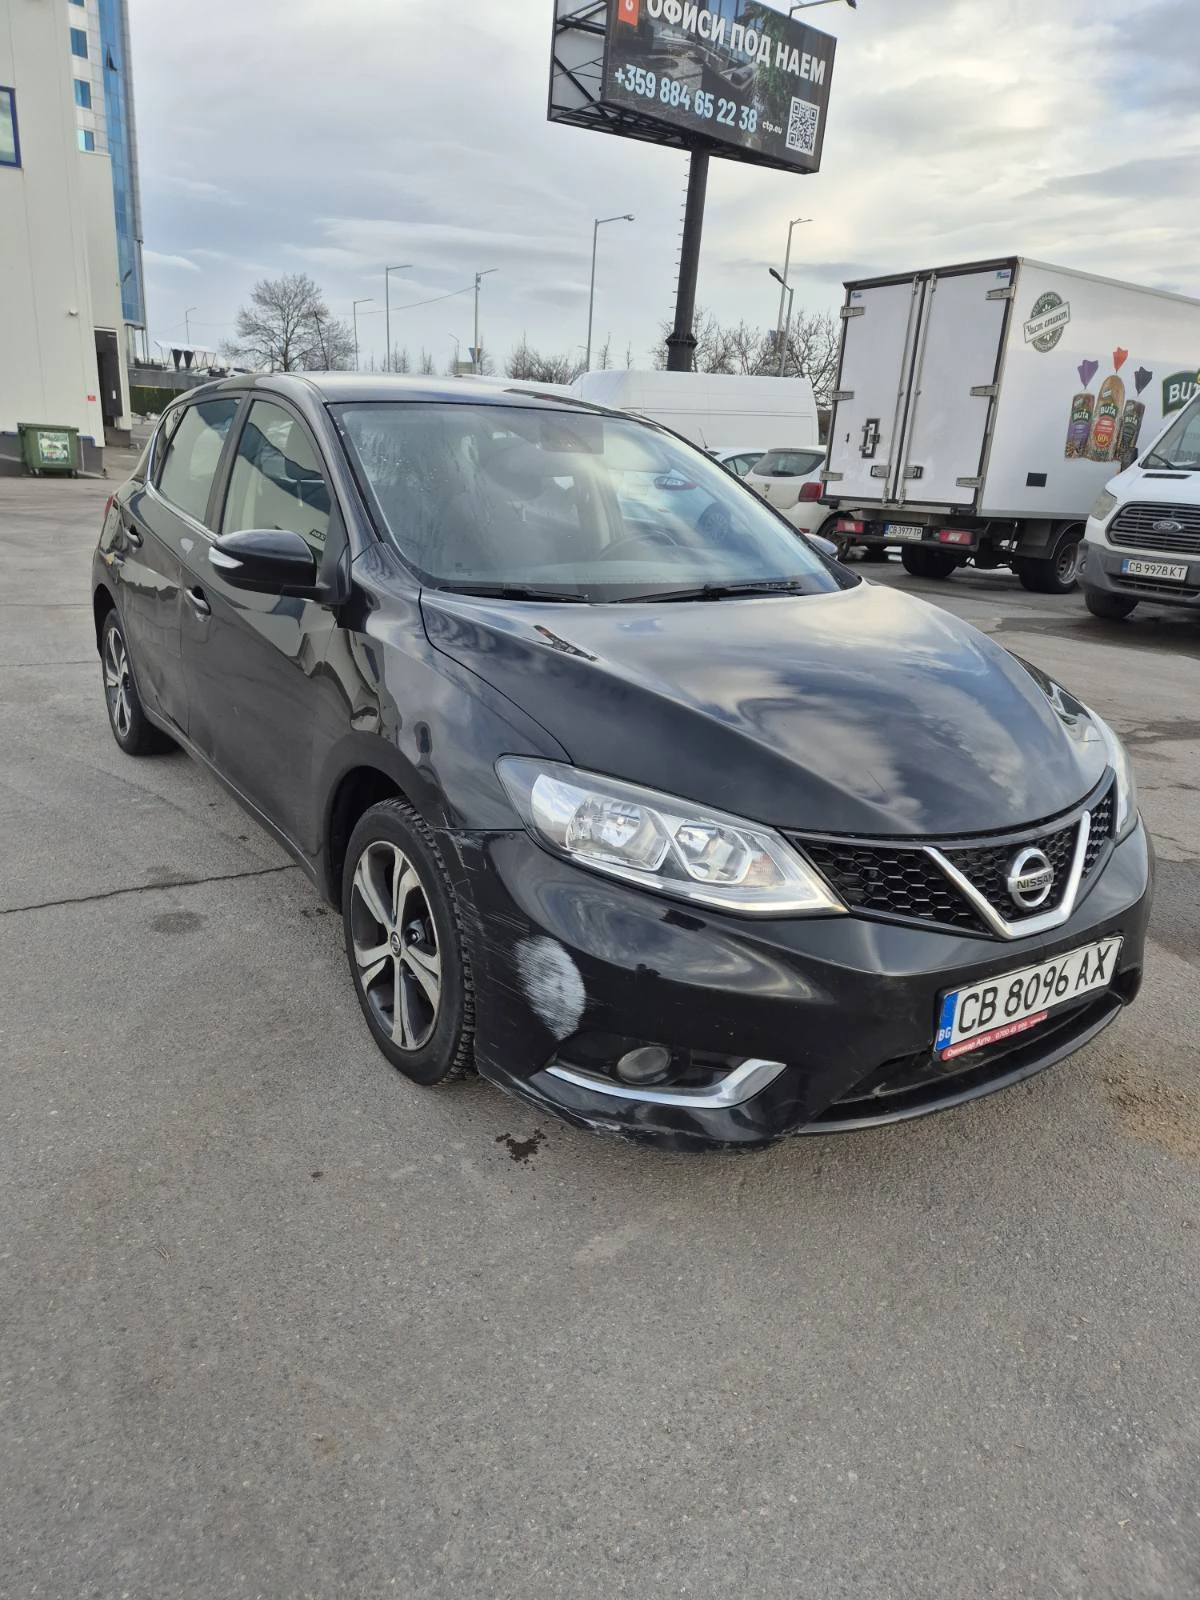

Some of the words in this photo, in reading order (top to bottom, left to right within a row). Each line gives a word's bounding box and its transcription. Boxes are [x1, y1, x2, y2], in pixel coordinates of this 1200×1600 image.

[647, 0, 726, 45] ОФИСИ
[730, 23, 771, 68] ПОД
[775, 42, 826, 85] НАЕМ
[614, 63, 656, 98] +359
[660, 77, 691, 111] 884
[694, 89, 715, 118] 65
[716, 98, 736, 126] 22
[739, 105, 758, 133] 38
[762, 120, 783, 135] ctp.eu
[1129, 562, 1142, 573] CB
[1169, 567, 1185, 577] KT
[1016, 872, 1053, 890] NISSAN
[958, 986, 998, 1034] CB
[1004, 961, 1070, 1018] 8096
[1074, 943, 1114, 991] AX
[938, 1026, 952, 1042] BG
